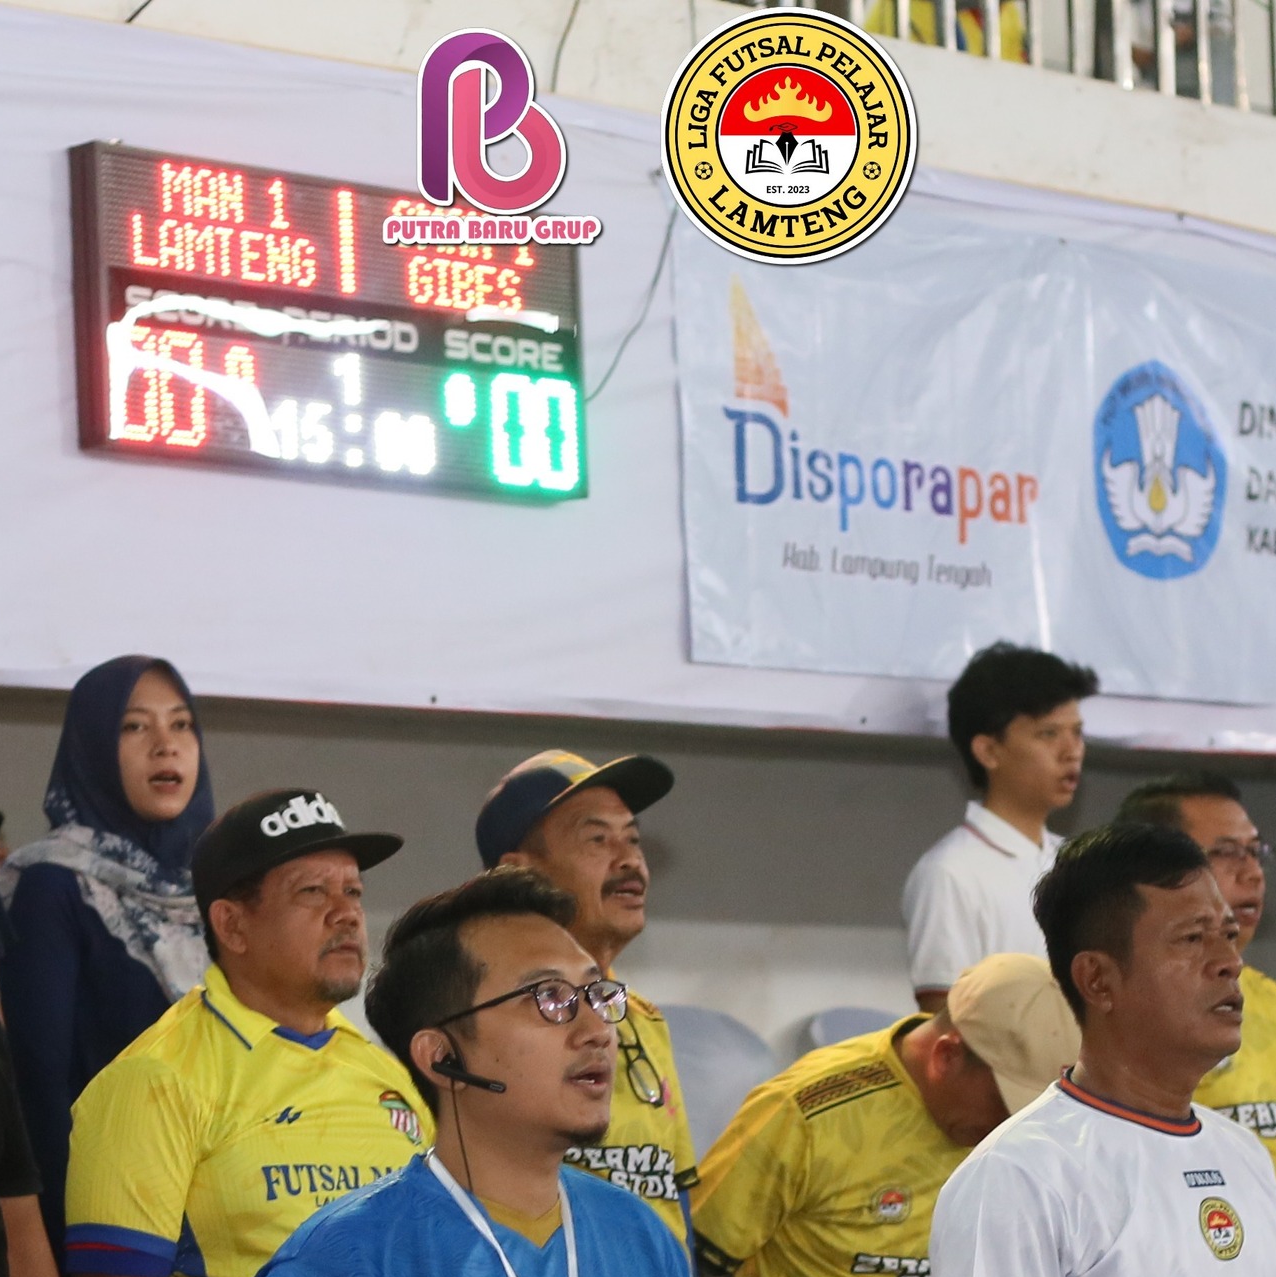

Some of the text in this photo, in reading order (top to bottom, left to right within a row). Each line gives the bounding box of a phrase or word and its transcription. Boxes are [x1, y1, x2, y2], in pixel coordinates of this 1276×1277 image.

[444, 329, 564, 372] SCORE
[333, 352, 363, 406] 1
[722, 404, 1039, 546] Disporapar
[830, 546, 920, 587] Lampung
[926, 552, 992, 590] Tengah
[260, 1162, 366, 1202] FUTSAL
